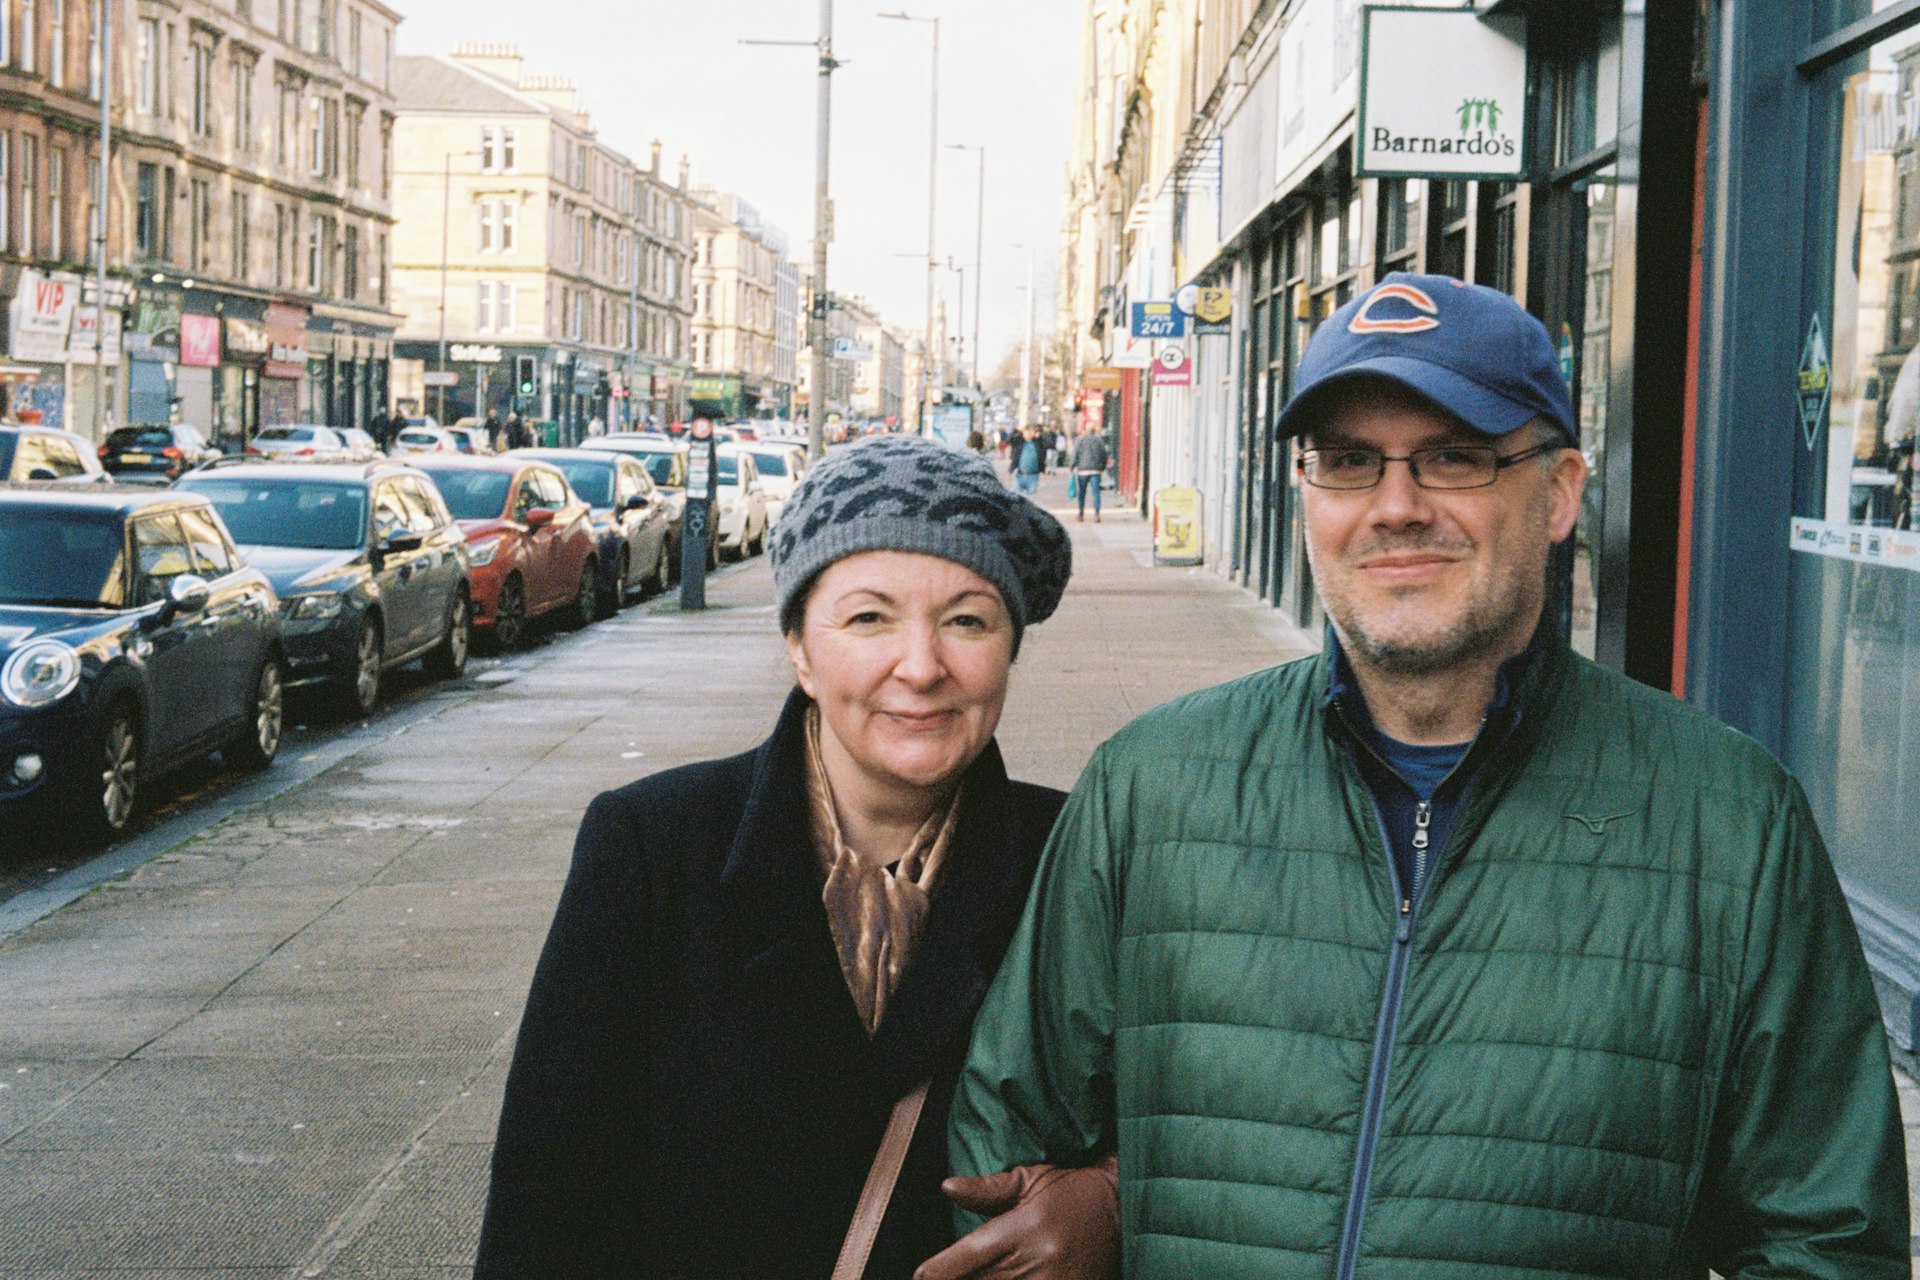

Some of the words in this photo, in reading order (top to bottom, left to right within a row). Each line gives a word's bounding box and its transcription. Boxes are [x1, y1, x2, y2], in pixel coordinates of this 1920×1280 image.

[1372, 127, 1515, 156] Barnardo's
[36, 280, 64, 315] VIP
[1141, 322, 1175, 335] 24/7
